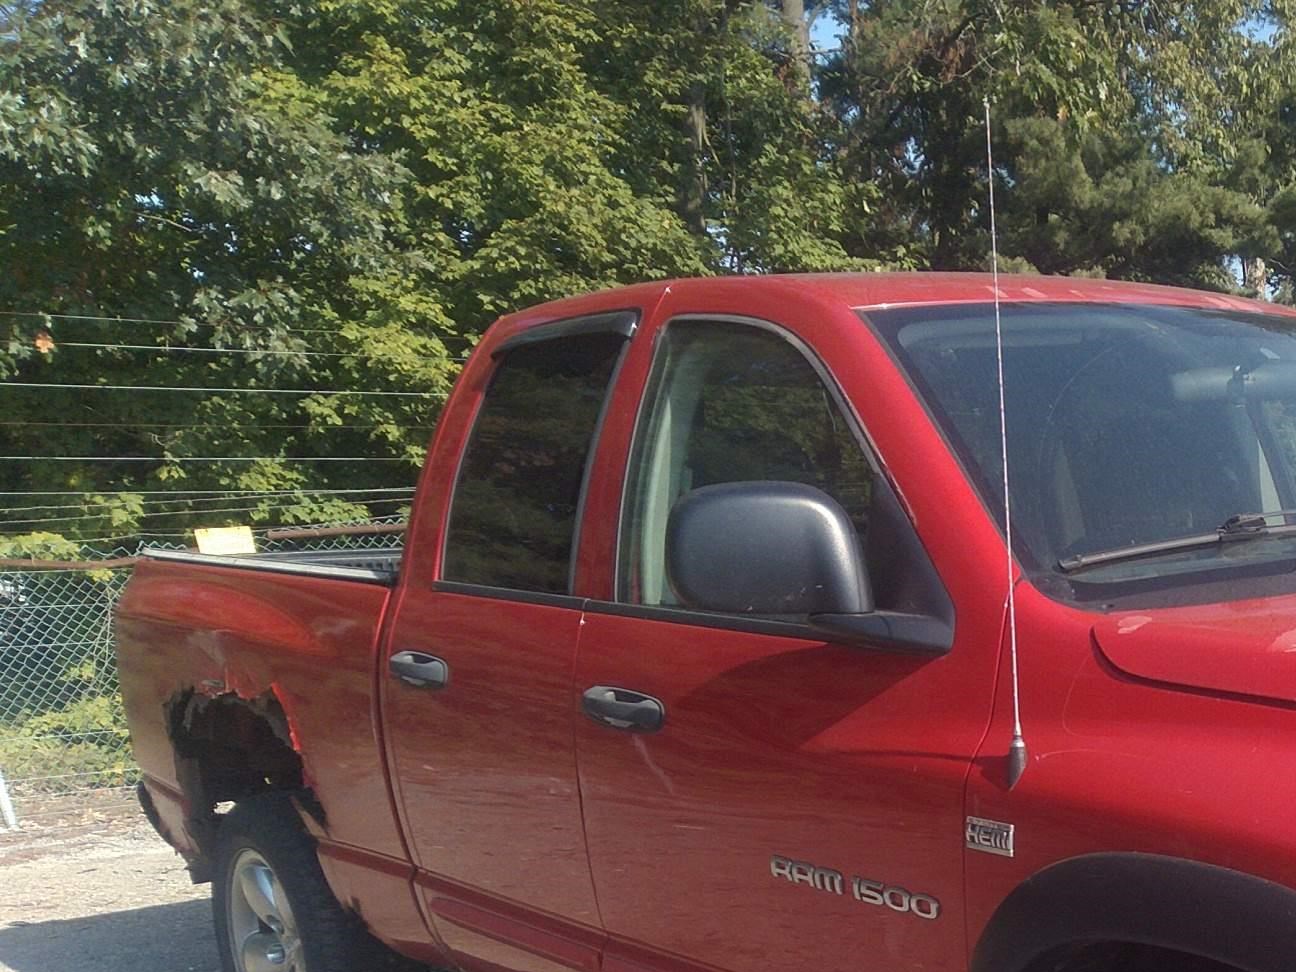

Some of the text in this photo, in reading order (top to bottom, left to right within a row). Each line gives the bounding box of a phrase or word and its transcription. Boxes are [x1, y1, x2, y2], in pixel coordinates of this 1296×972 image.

[966, 822, 1014, 852] HEMI
[770, 856, 940, 920] RAM 1500
